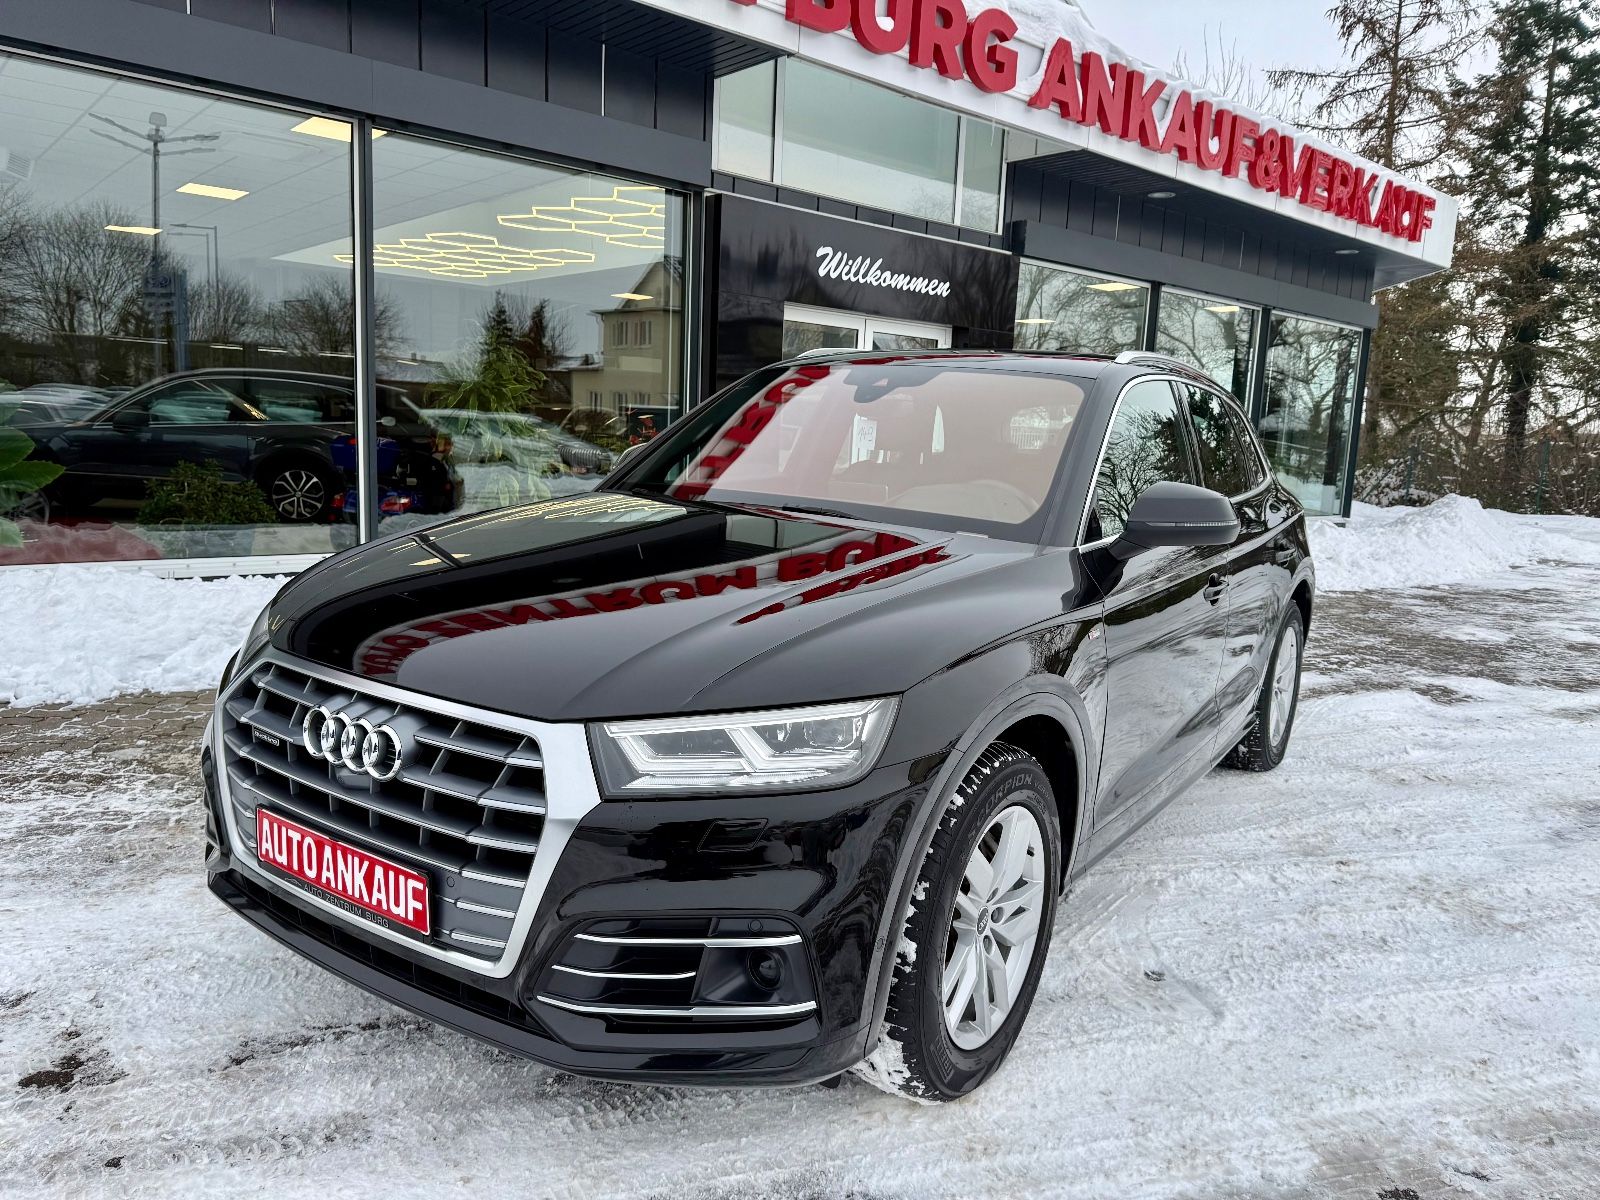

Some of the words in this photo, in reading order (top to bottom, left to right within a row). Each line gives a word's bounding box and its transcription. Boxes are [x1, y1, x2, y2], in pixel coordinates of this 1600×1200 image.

[816, 246, 951, 298] Willkommen
[261, 818, 318, 879] AUTO
[321, 845, 424, 921] ANKAUF
[303, 883, 323, 899] AUTO
[325, 894, 362, 917] ZENTRUM
